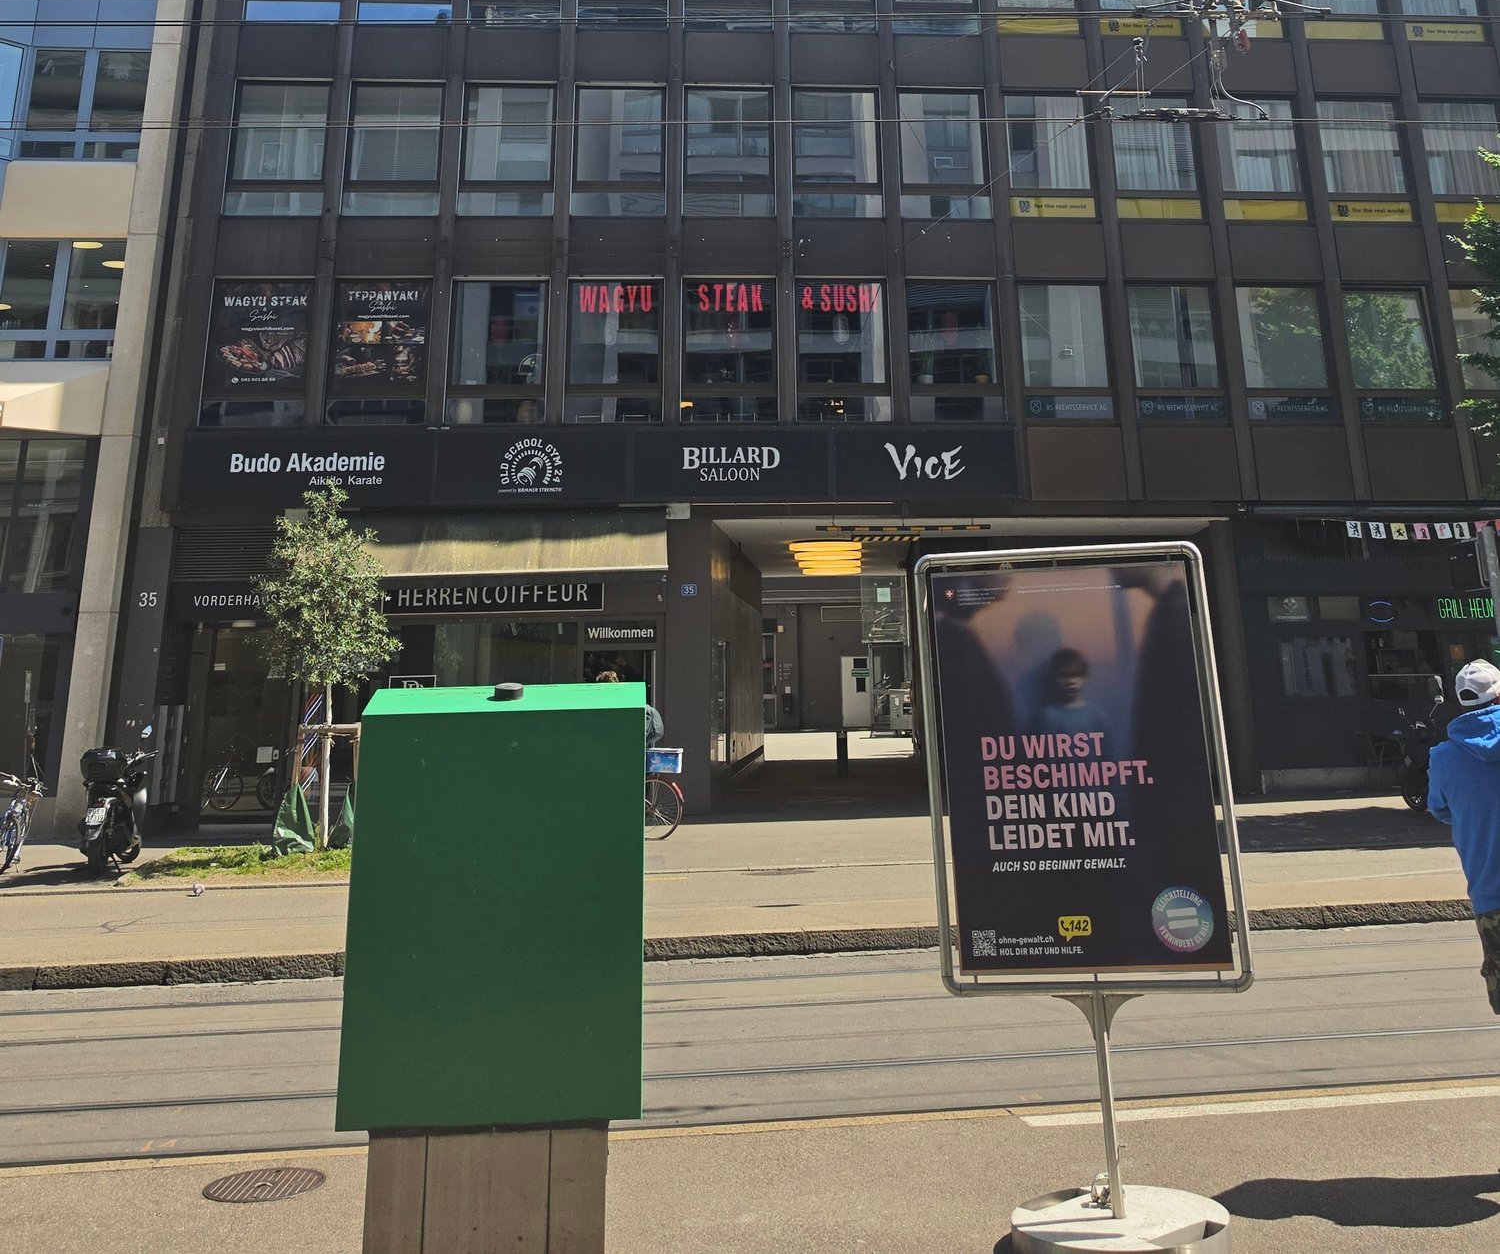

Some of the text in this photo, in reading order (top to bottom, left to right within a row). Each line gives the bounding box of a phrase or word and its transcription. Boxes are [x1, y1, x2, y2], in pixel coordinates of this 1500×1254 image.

[224, 295, 307, 307] WAGYU STEAK
[348, 290, 419, 302] TEPPANYAKI
[579, 282, 880, 314] WAGYU STEAK & SUSHI
[368, 300, 397, 313] Sushi
[249, 309, 278, 322] Sushi
[230, 451, 385, 473] Budo Akademie
[500, 438, 563, 485] OLD SCHOOL GYM 24
[682, 446, 781, 470] BILLARD
[348, 475, 383, 485] Karate
[699, 467, 761, 481] SALOON
[398, 583, 589, 607] HERRENCOIFFEUR
[683, 585, 695, 595] 35
[138, 592, 158, 607] 35
[1437, 598, 1468, 619] GRILL
[588, 626, 654, 639] Willkommen
[980, 731, 1104, 761] DU WIRST
[983, 760, 1154, 791] BESCHIMPFT.
[986, 791, 1116, 820] DEIN KIND
[988, 820, 1136, 850] LEIDET MIT.
[992, 857, 1127, 872] AUCH SO BEGINNT GEWALT.
[1156, 889, 1203, 913] GLEICHSTELLUNG
[1069, 919, 1089, 932] 142
[998, 935, 1055, 945] ohne-gewalt.ch
[1159, 920, 1210, 948] VERHINDERT GEWALT
[999, 945, 1084, 956] HOL DIR RAT UND HILFE.
